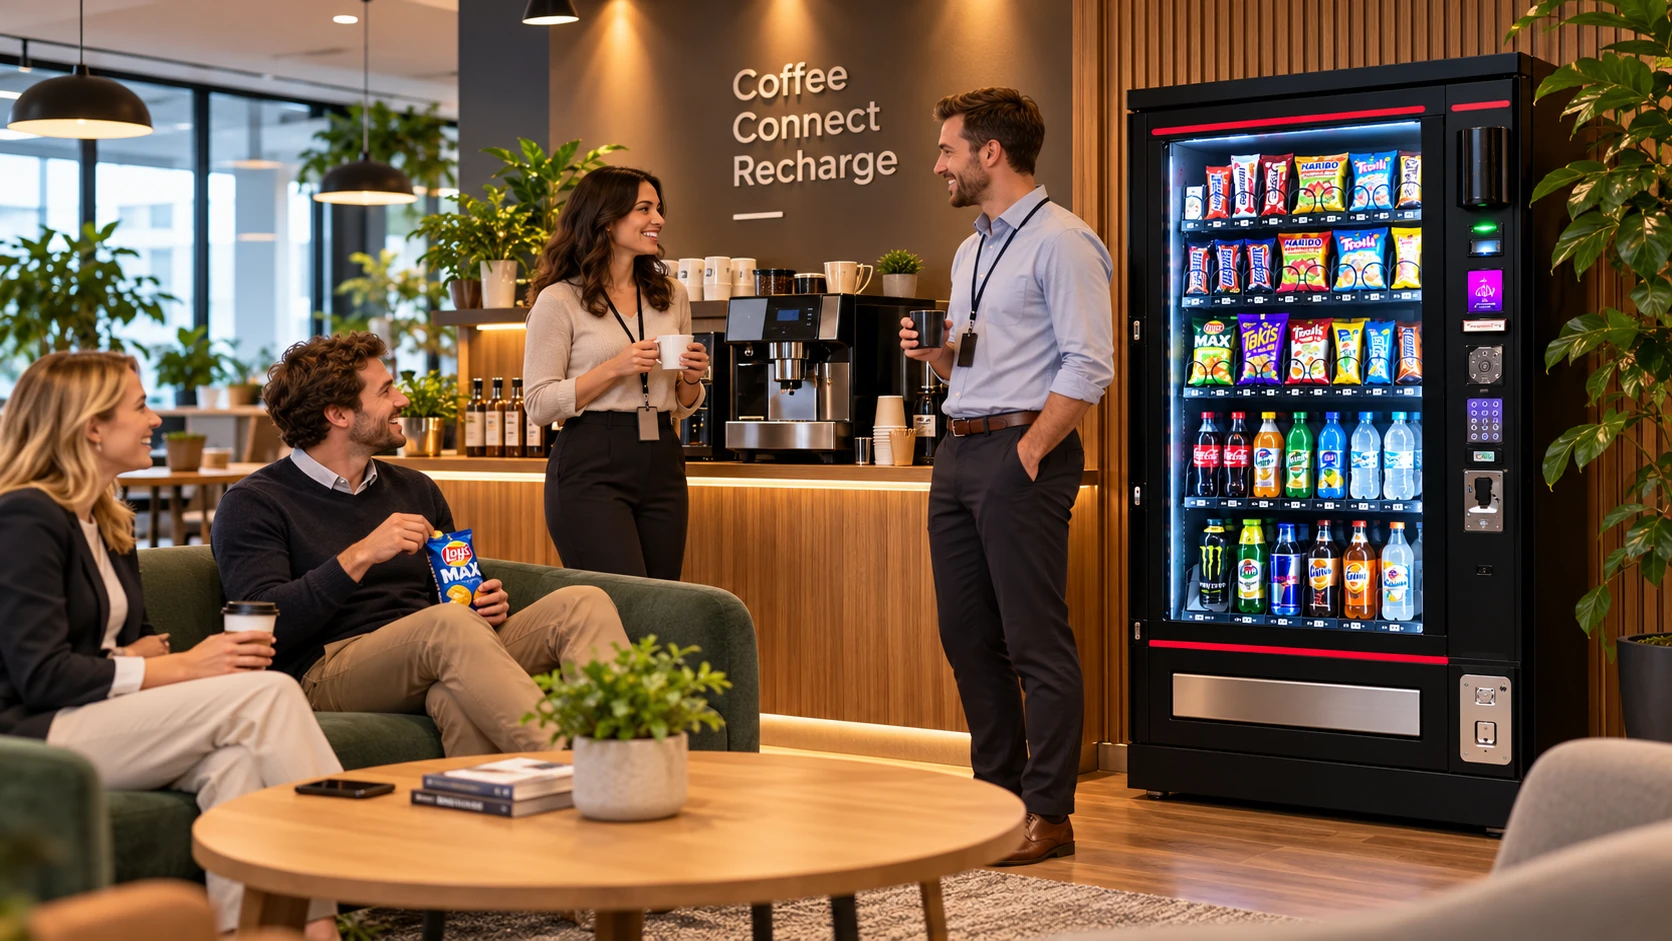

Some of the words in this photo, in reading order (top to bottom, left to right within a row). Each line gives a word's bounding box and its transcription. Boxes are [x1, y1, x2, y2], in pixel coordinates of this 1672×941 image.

[732, 61, 848, 101] Coffee
[732, 101, 881, 144] Connect
[733, 149, 898, 187] Recharge
[1194, 334, 1231, 348] MAX
[1242, 325, 1279, 352] Takis
[440, 561, 482, 584] MAX
